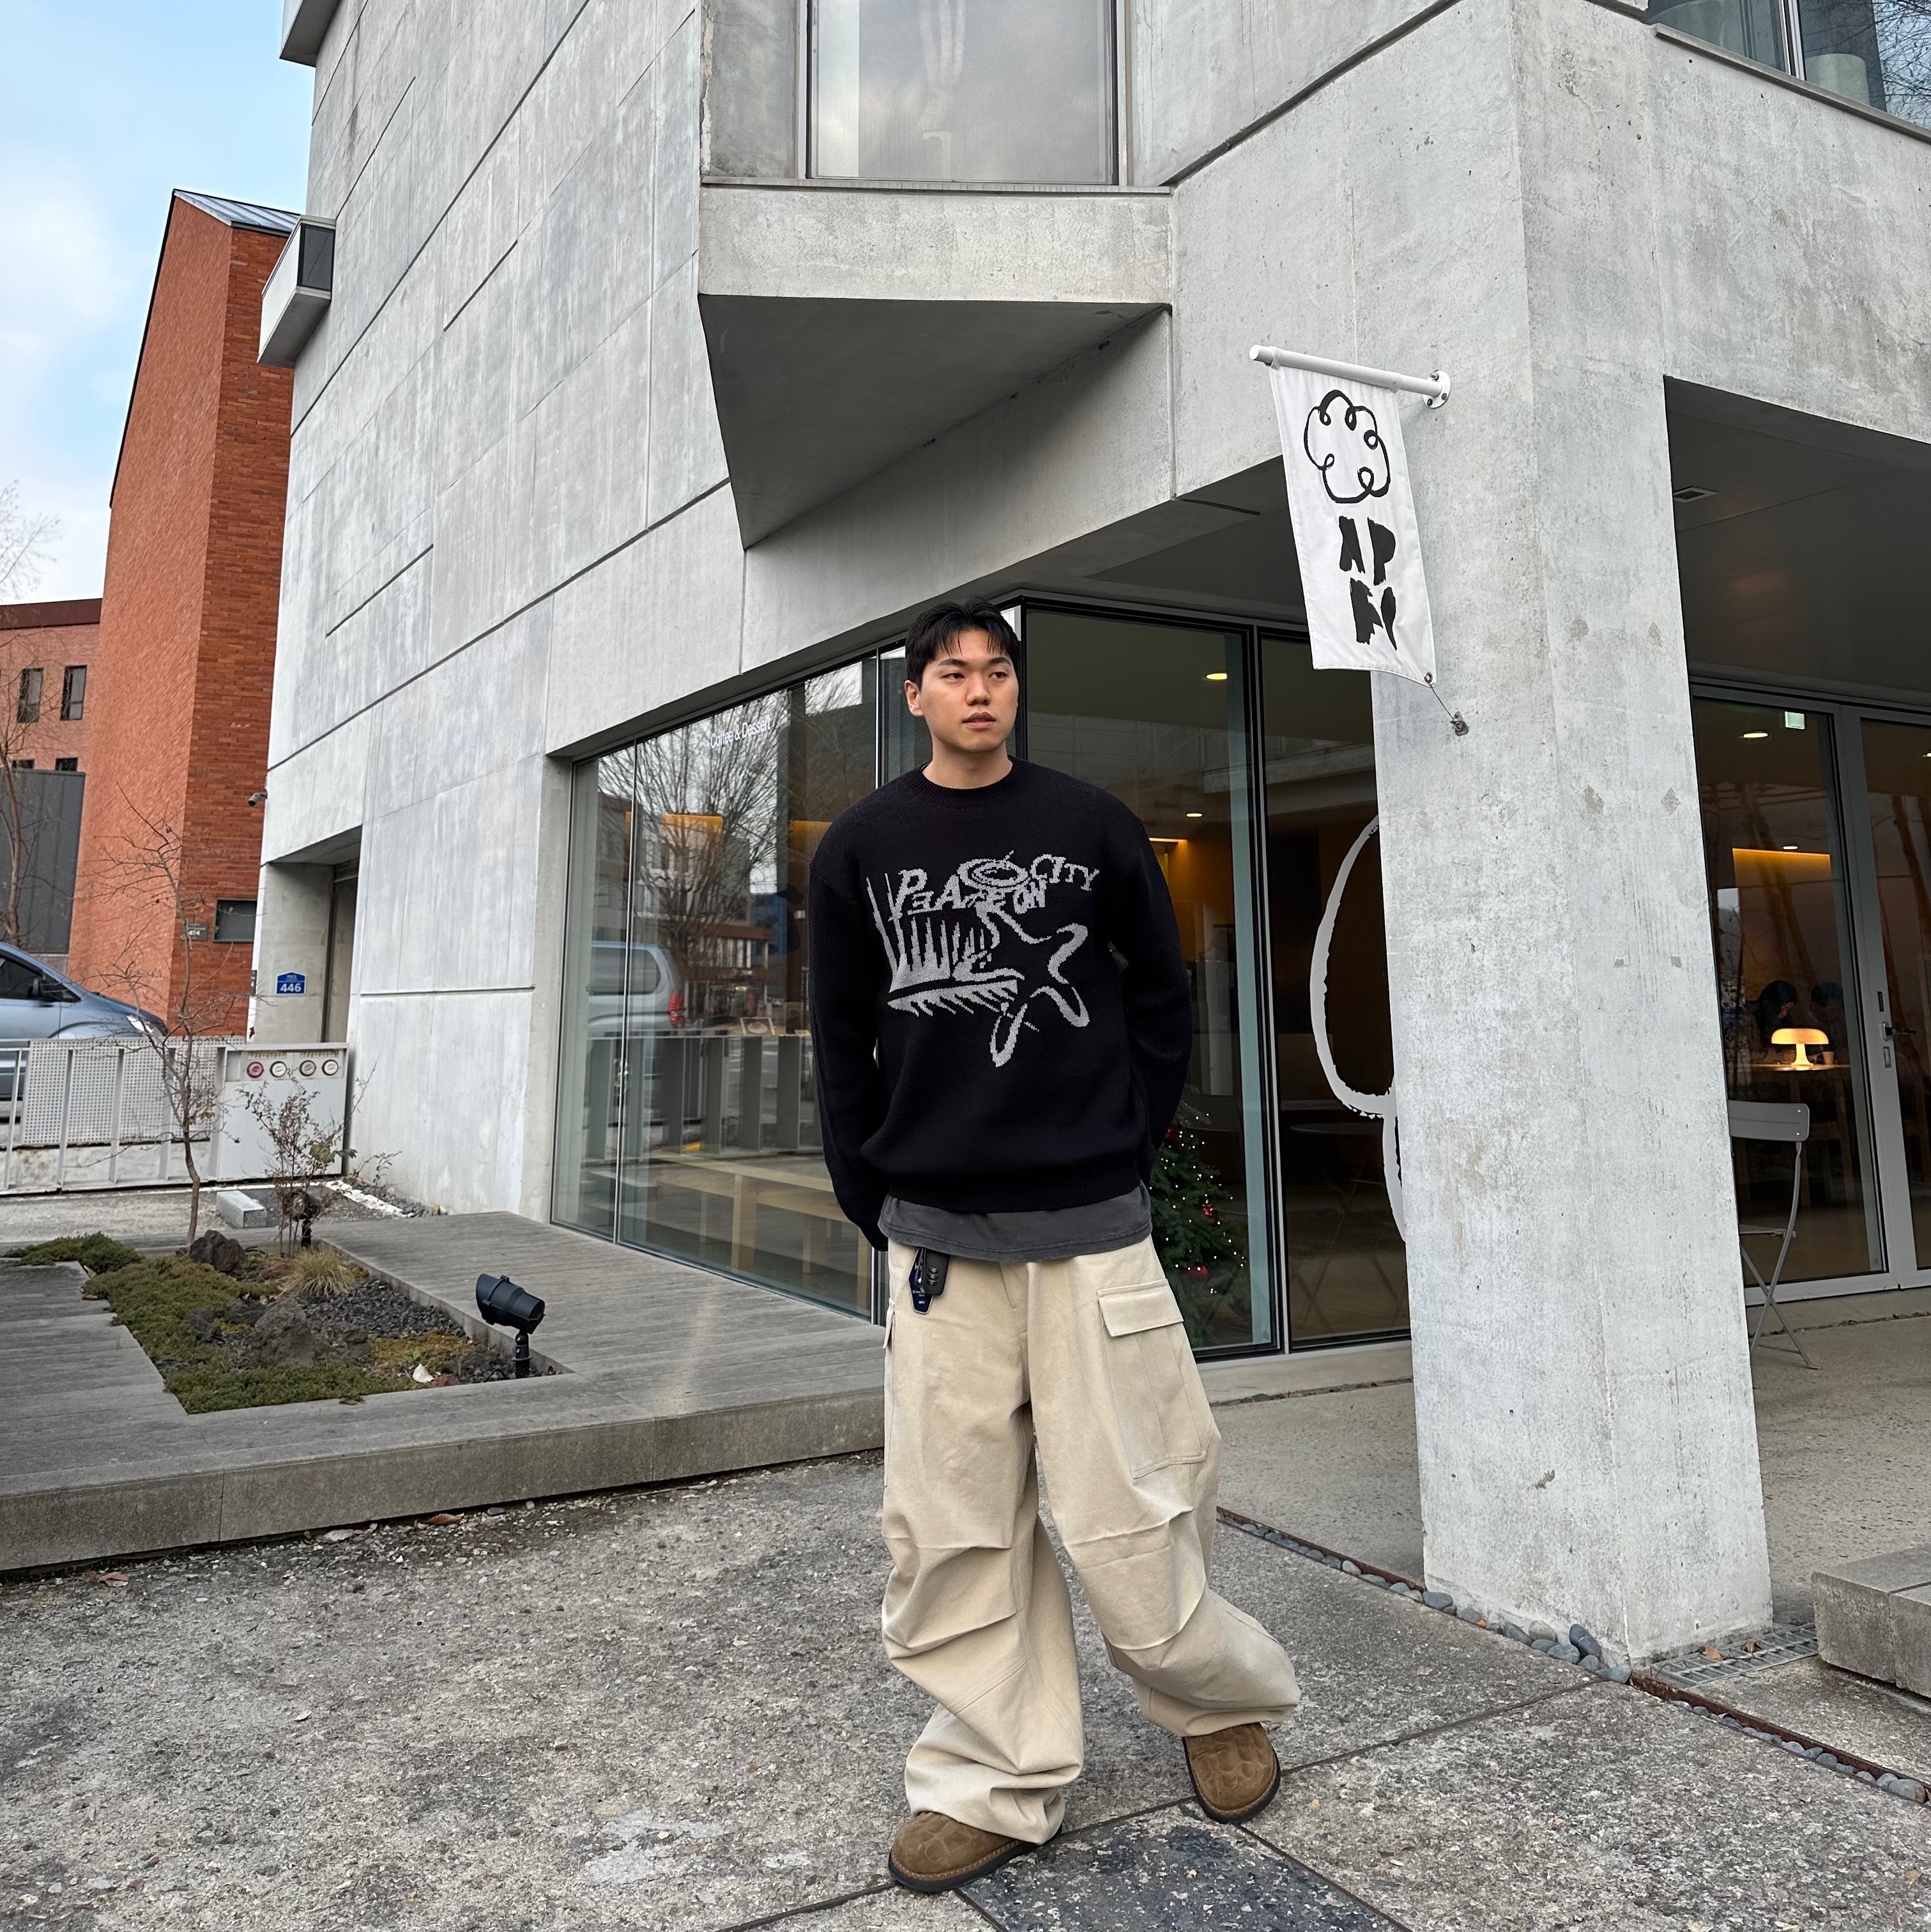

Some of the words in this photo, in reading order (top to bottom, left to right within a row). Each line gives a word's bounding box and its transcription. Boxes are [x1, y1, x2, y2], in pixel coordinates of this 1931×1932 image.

[710, 731, 734, 748] Coffee
[735, 723, 741, 741] &
[742, 714, 771, 739] Dessert
[1030, 854, 1100, 891] CITY
[280, 983, 301, 993] 446
